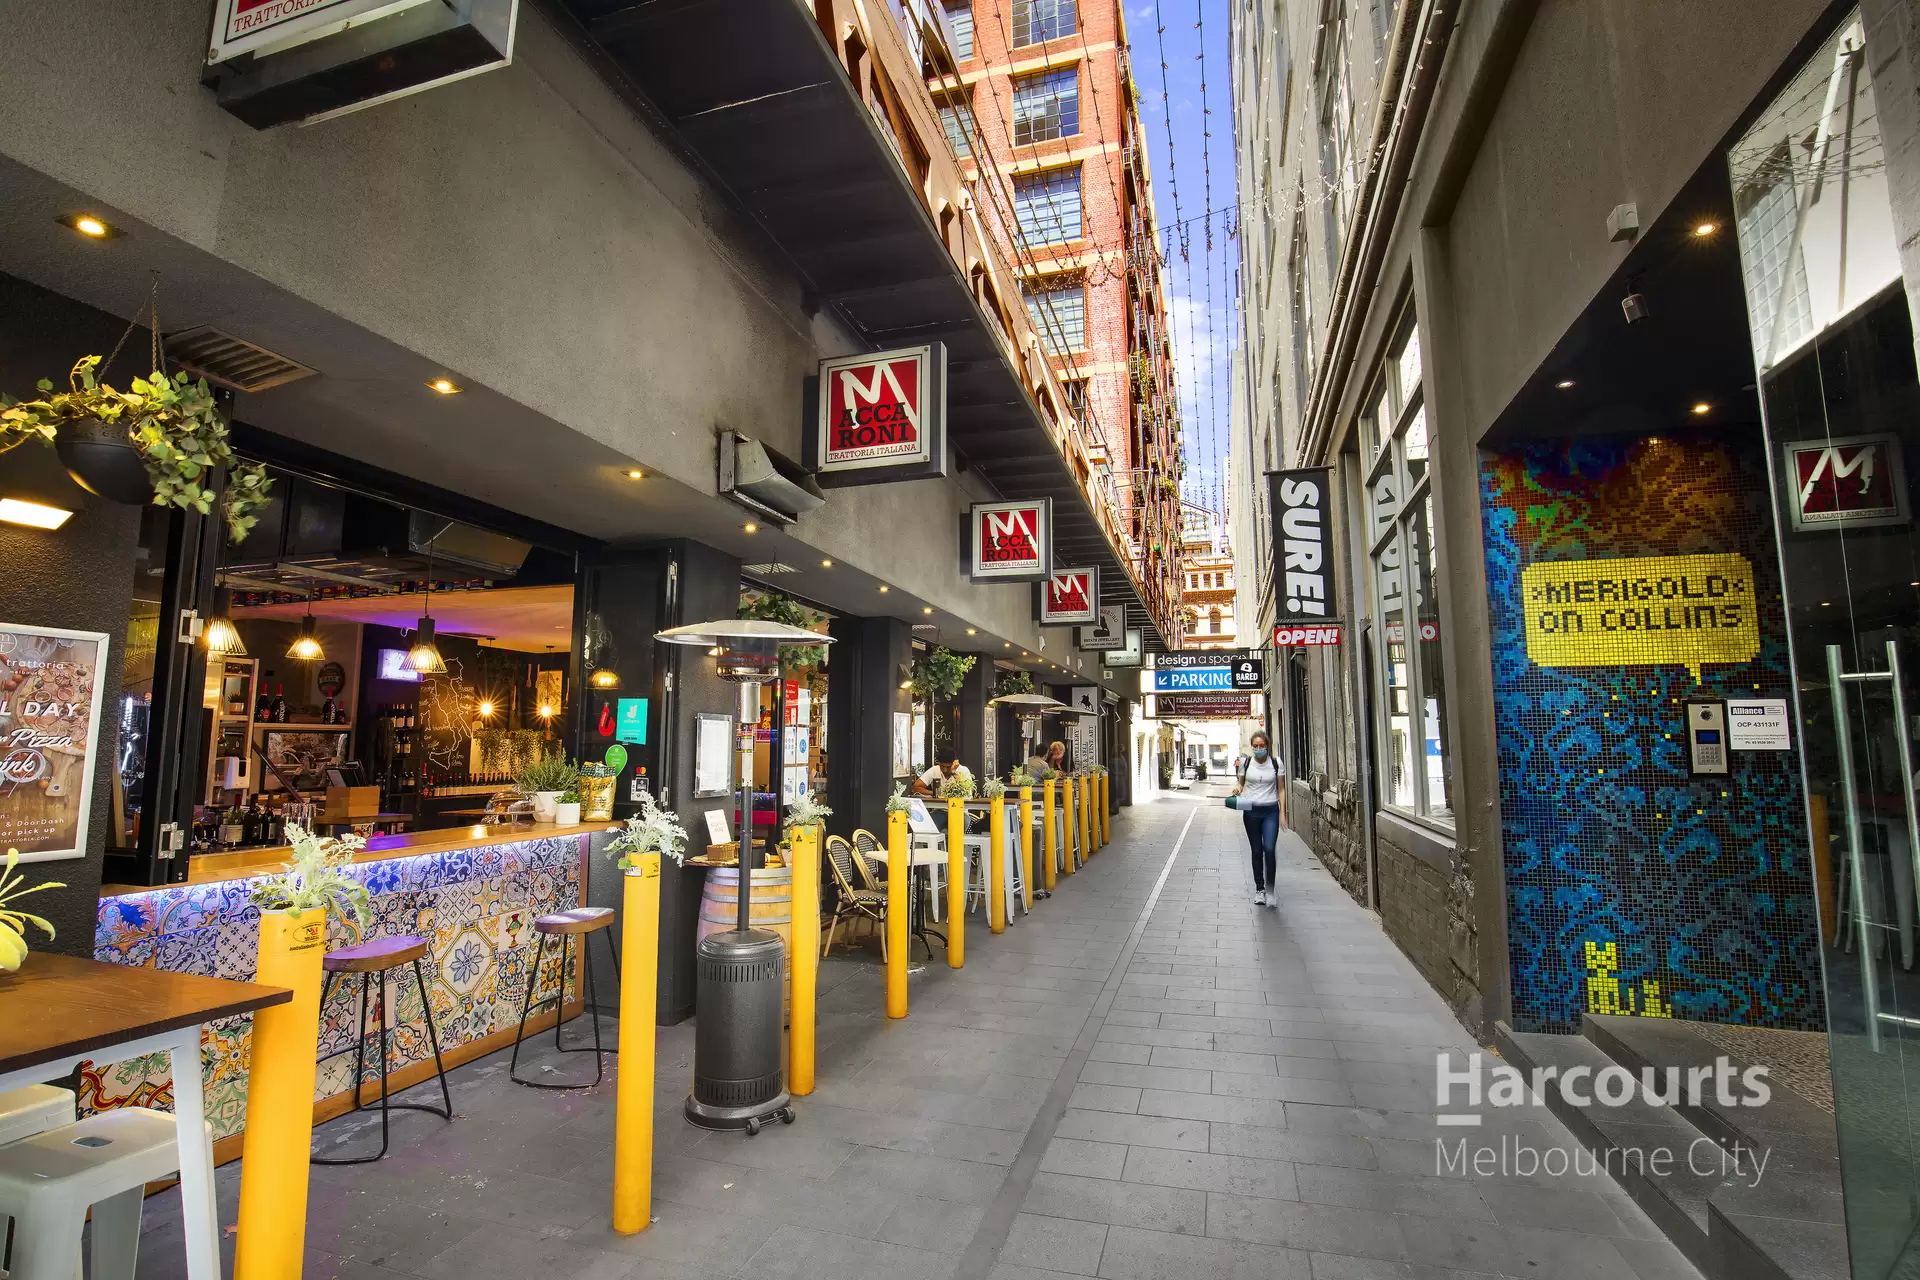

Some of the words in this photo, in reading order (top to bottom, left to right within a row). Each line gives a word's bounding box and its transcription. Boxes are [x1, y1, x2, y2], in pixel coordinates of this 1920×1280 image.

[838, 423, 909, 448] RONI
[829, 447, 875, 460] TRATTORIA
[876, 444, 917, 456] ITALIANA
[985, 534, 1032, 549] ACCA
[1281, 478, 1325, 615] SURE!
[985, 548, 1032, 562] RONI
[1546, 575, 1728, 603] MERIGOLD
[1050, 602, 1084, 612] RONI
[1276, 629, 1338, 645] OPEN!
[6, 658, 65, 669] trattoria
[1157, 654, 1196, 666] design
[1198, 656, 1207, 664] a
[1171, 673, 1232, 687] PARKING
[1236, 673, 1258, 681] BARED
[23, 701, 80, 717] DAY
[1732, 707, 1763, 715] Alliance
[8, 728, 73, 748] Pizza
[17, 818, 65, 827] DoorDash
[17, 828, 39, 836] pick
